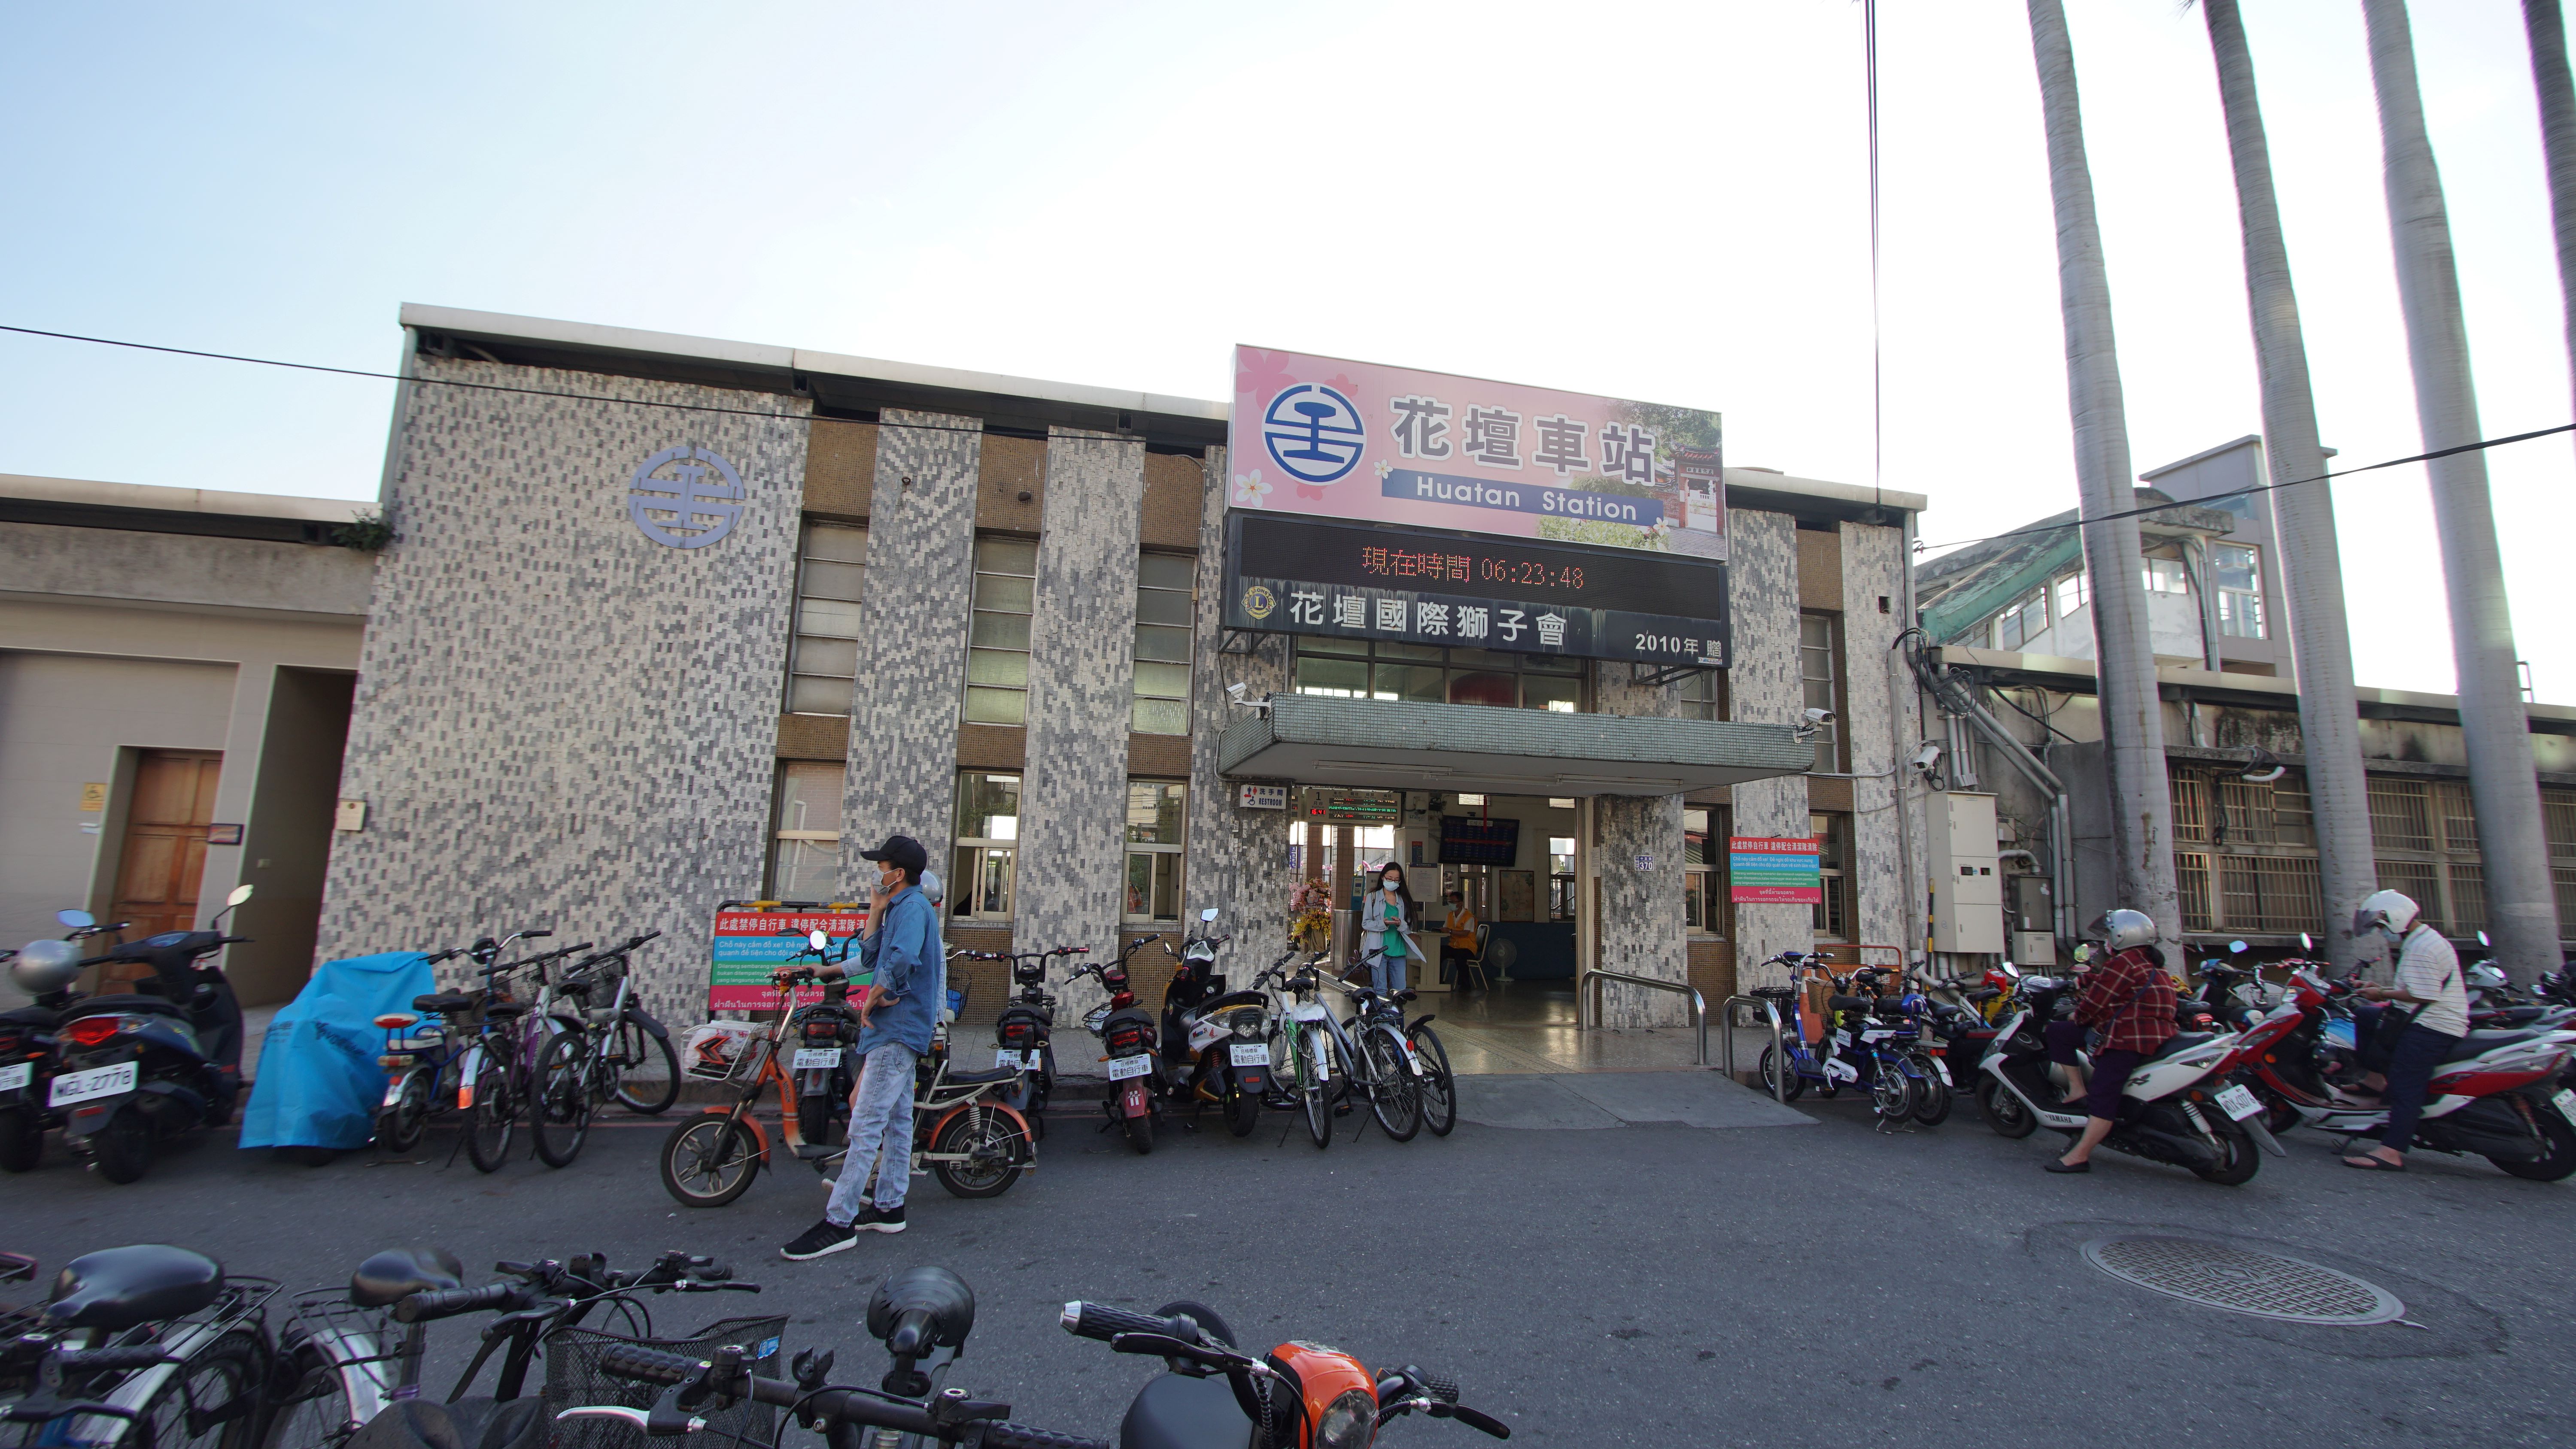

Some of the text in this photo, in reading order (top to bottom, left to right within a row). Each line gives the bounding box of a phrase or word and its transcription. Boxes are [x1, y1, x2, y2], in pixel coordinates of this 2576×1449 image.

[1393, 398, 1653, 483] 花壇車站
[1417, 476, 1637, 521] Huatan Station
[1362, 546, 1584, 589] 現在時間 06:23:48
[1289, 590, 1567, 646] 花壇國際獅子會
[1635, 633, 1722, 658] 2010年 贈
[1259, 788, 1283, 797] 洗手間
[1258, 798, 1282, 806] RESTROOM
[1640, 862, 1653, 870] 370
[719, 918, 868, 932] 此處禁停自行車 違停配合清潔隊清
[796, 1058, 836, 1067] 電動自行車
[998, 1059, 1036, 1068] 電動自車
[1233, 1054, 1268, 1064] 電動自行車
[1112, 1064, 1149, 1078] 電動自行車
[2047, 1114, 2073, 1124] YAMAHA
